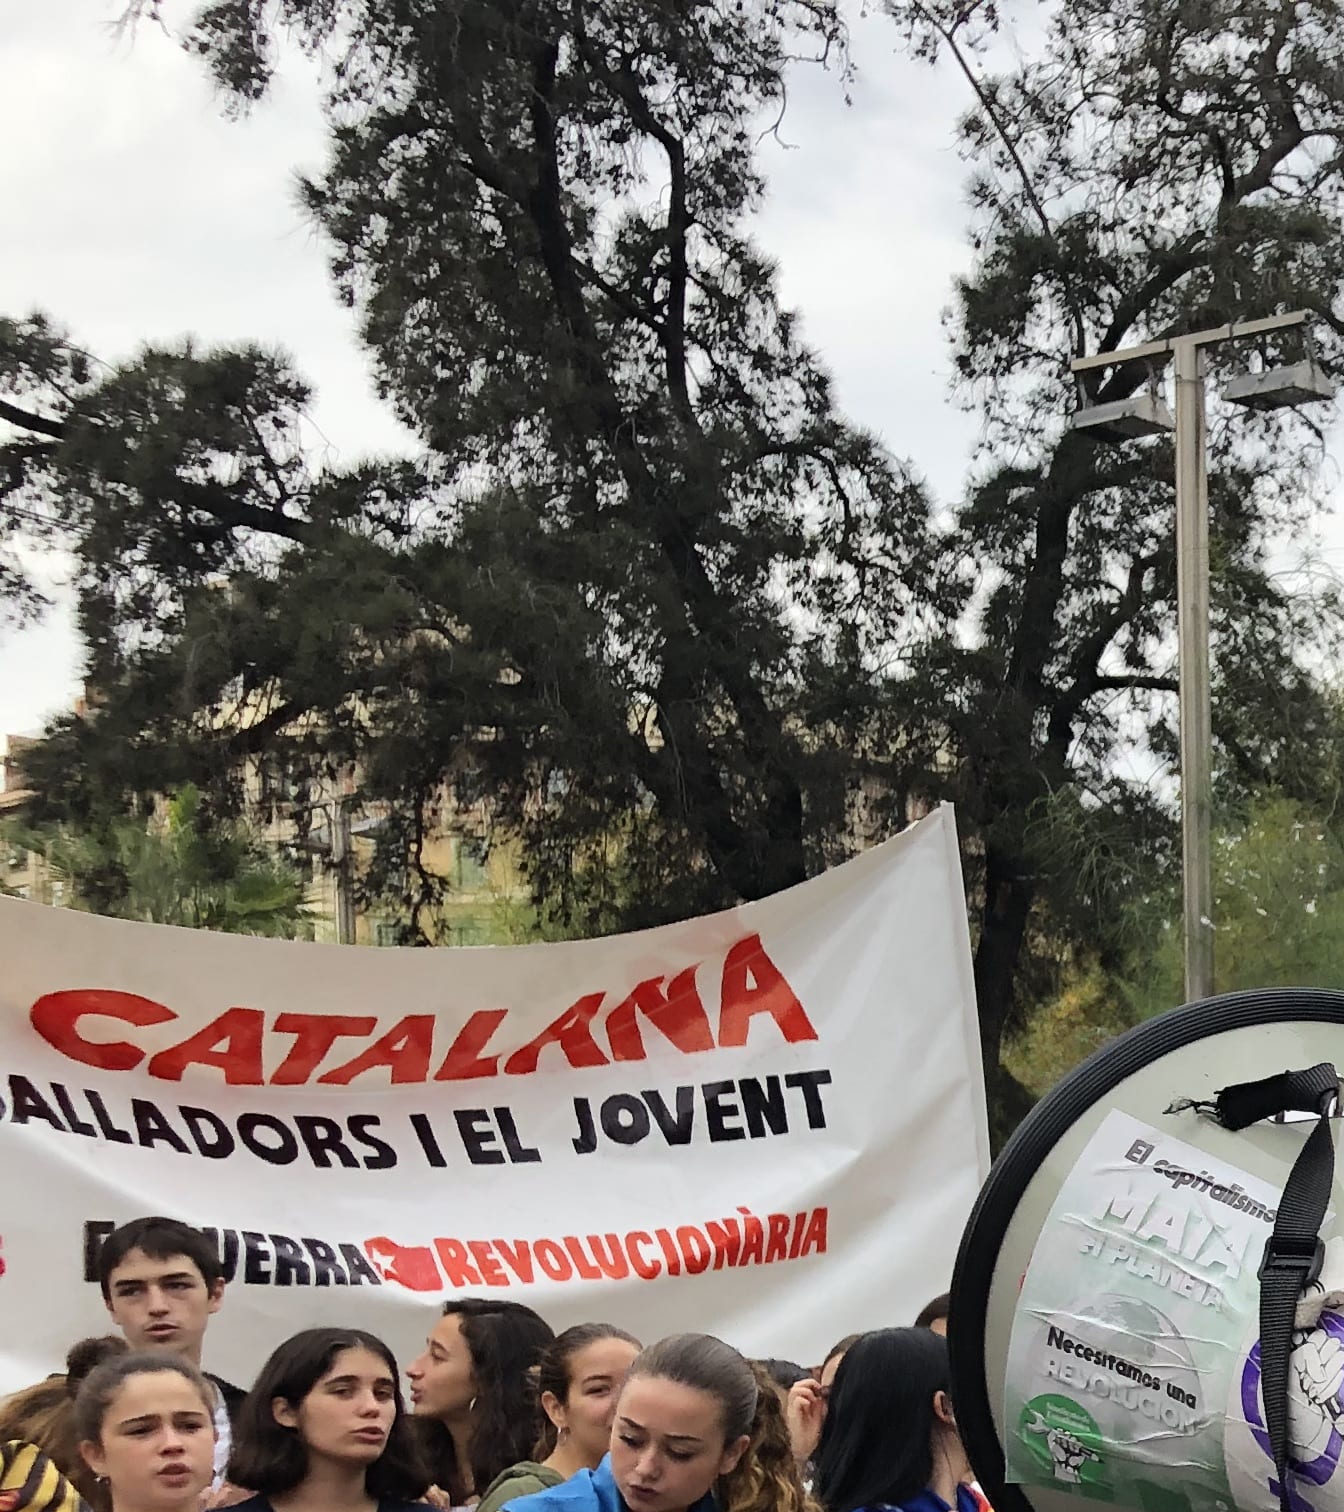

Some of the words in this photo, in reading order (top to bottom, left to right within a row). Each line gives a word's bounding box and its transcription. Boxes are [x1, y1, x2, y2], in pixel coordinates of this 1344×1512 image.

[30, 933, 817, 1086] CATALANA
[0, 1074, 398, 1170] ALLADORS
[411, 1112, 447, 1167] I
[464, 1106, 541, 1164] EL
[572, 1069, 832, 1155] JOVENT
[1124, 1139, 1154, 1165] El
[1152, 1159, 1278, 1223] capitalismo
[441, 1205, 828, 1289] REVOLUCIONÀRIA
[1093, 1188, 1251, 1280] MATA
[1046, 1325, 1160, 1391] Necesitamos
[1166, 1381, 1198, 1410] una
